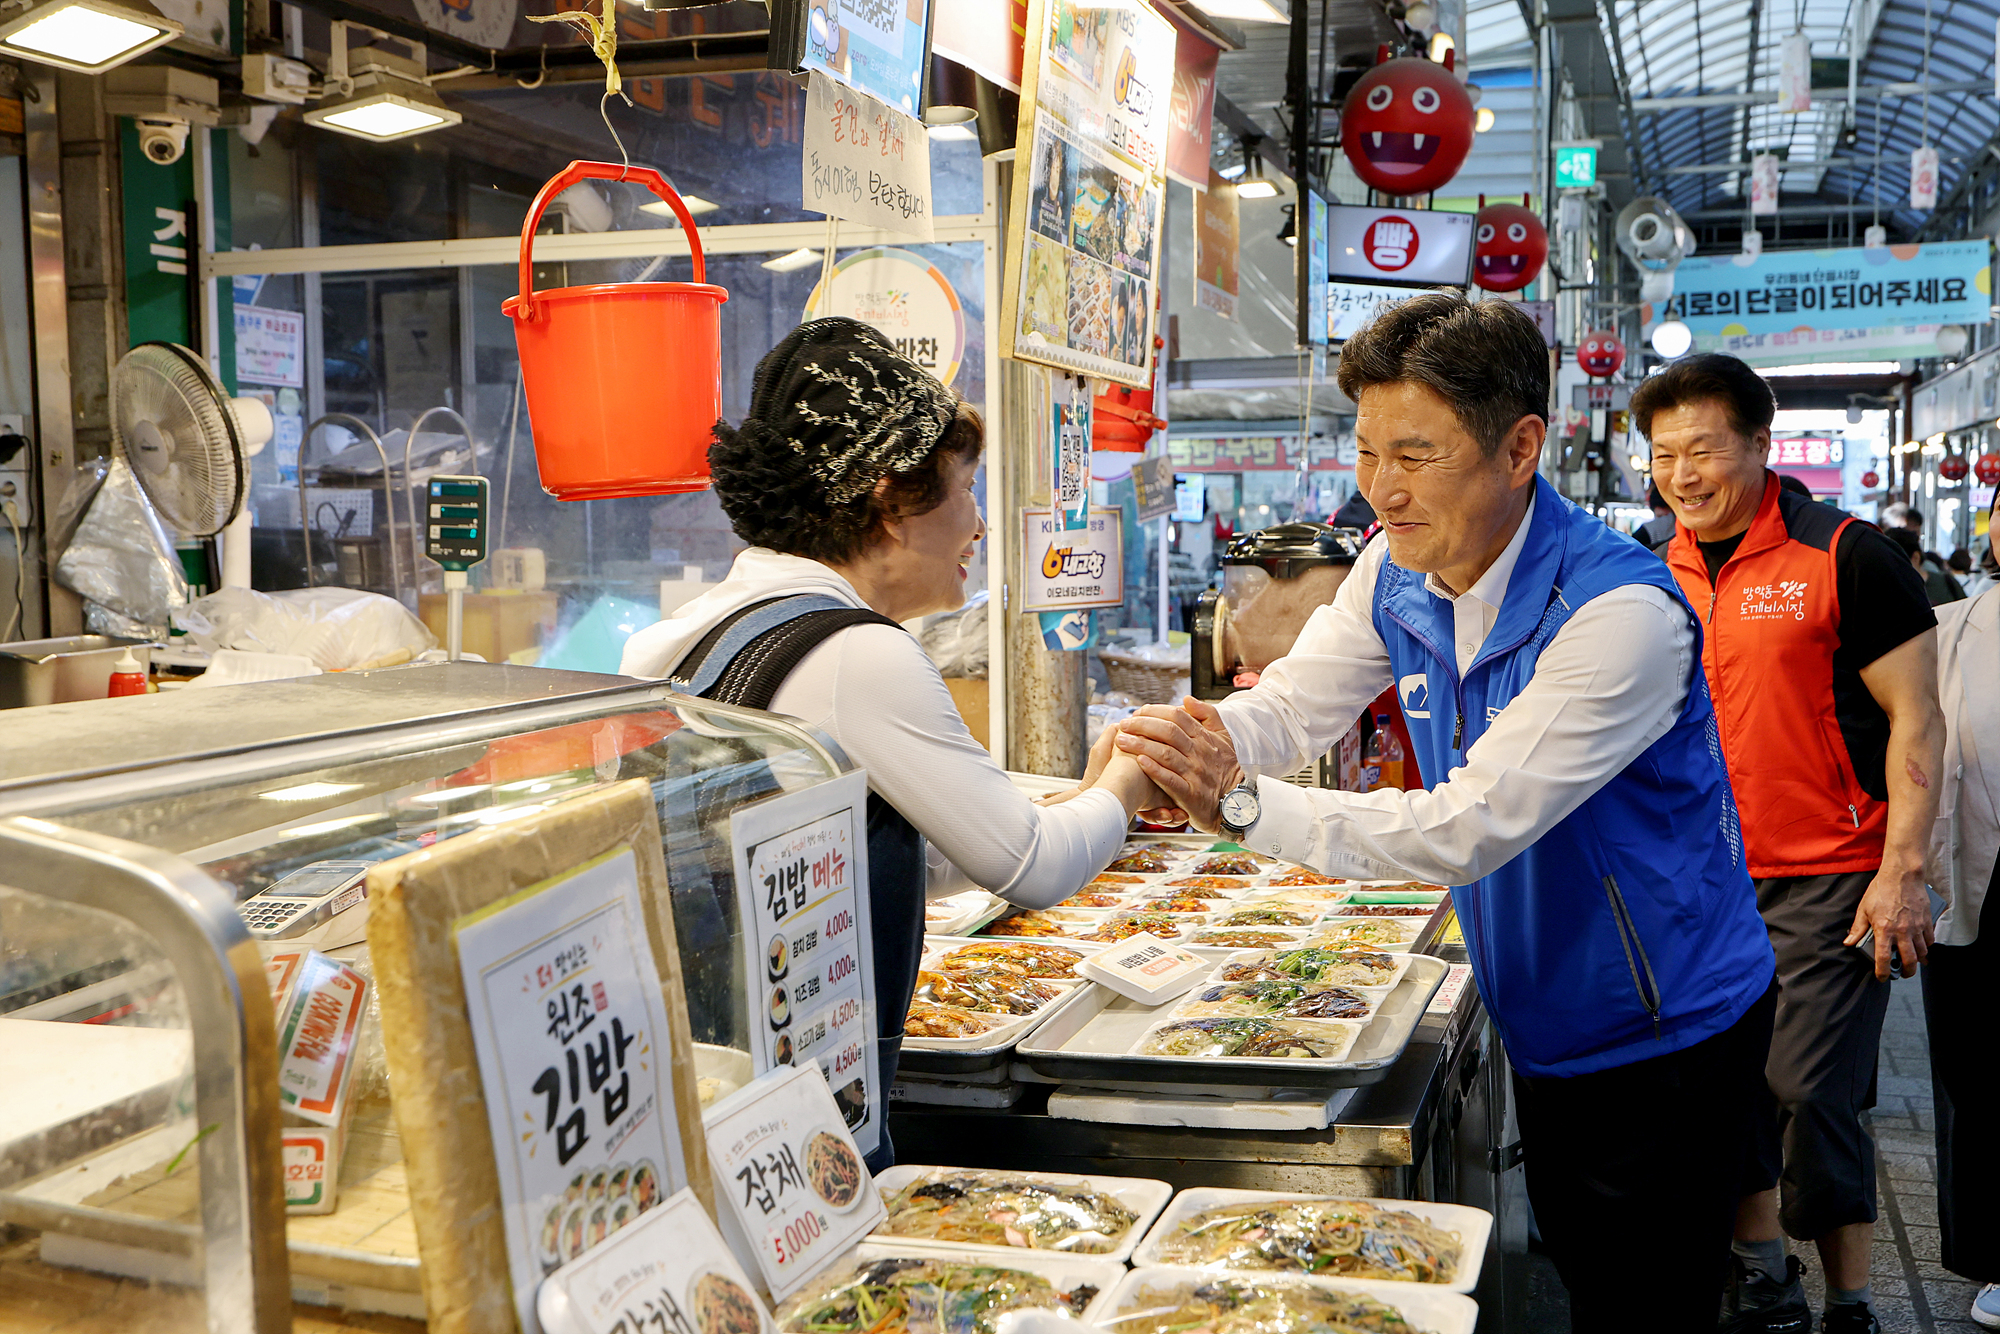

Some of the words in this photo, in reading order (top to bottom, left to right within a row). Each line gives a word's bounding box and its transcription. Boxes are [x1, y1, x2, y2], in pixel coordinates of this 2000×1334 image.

[1116, 9, 1135, 37] KBS
[1105, 113, 1127, 150] 이모네
[810, 151, 862, 203] 동시이행
[1747, 285, 1825, 314] 단골이
[1062, 551, 1106, 579] 내고향
[1743, 585, 1773, 601] 방학동
[1740, 600, 1804, 620] 도깨비시장
[764, 857, 809, 922] 김밥
[813, 848, 845, 889] 메뉴
[792, 936, 804, 958] 참치
[806, 929, 818, 951] 김밥
[536, 963, 553, 989] 더
[555, 943, 588, 977] 맛있는
[795, 984, 807, 1004] 치즈
[808, 975, 820, 998] 김밥
[547, 982, 595, 1046] 원조
[798, 1028, 814, 1052] 소고기
[815, 1020, 826, 1042] 김밥
[532, 1017, 635, 1167] 김밥
[283, 1164, 324, 1181] 호일
[736, 1143, 806, 1215] 잡채
[774, 1211, 829, 1264] 5,000원
